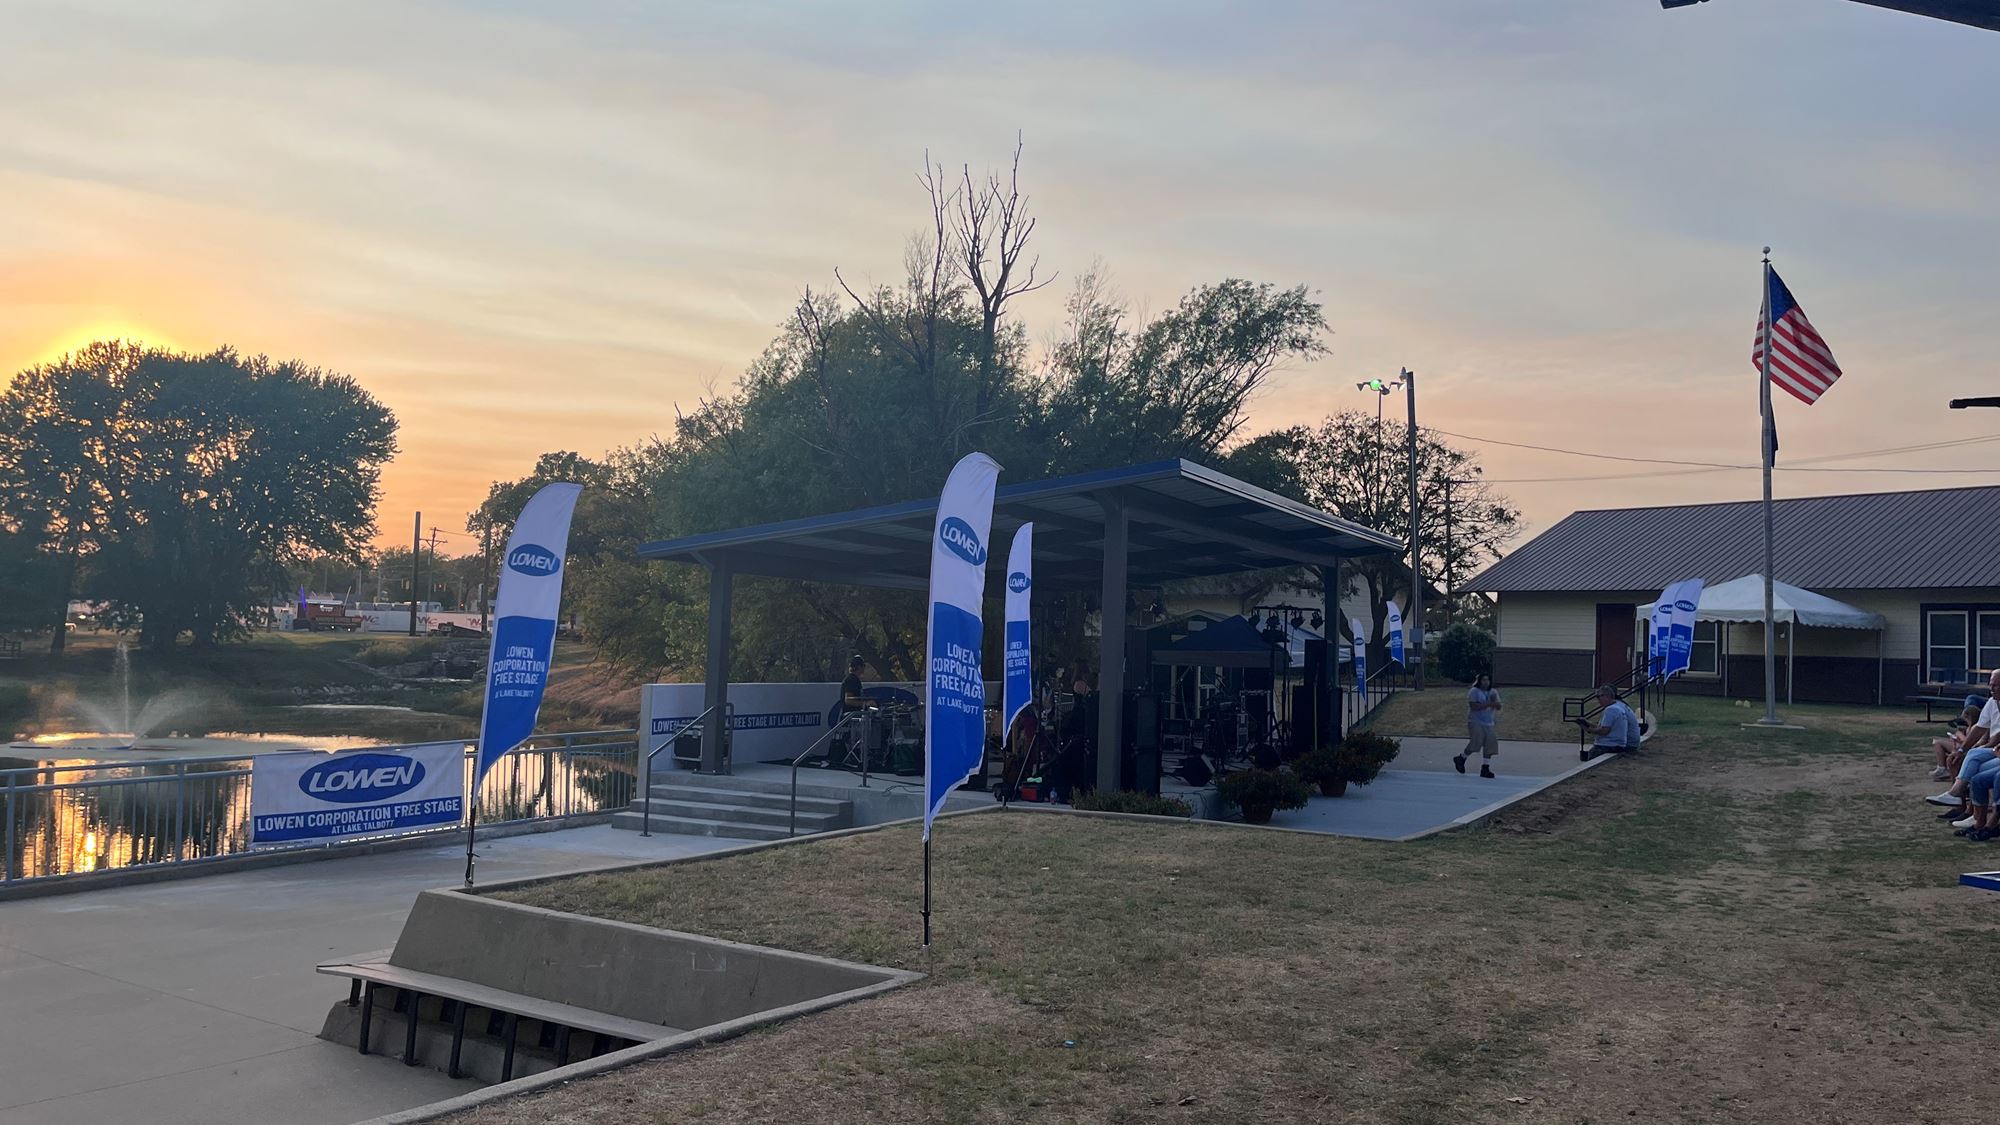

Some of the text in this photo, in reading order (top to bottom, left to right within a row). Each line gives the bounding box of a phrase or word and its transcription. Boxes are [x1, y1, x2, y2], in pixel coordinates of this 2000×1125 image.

[943, 523, 982, 561] LOWEN
[510, 552, 557, 571] LOWEN
[506, 646, 534, 659] LOWEN
[935, 674, 983, 700] FREE TAGE
[937, 697, 946, 706] AT
[947, 697, 962, 709] LAKE
[734, 716, 747, 728] REE
[747, 715, 768, 728] STAGE
[768, 715, 778, 727] AT
[777, 714, 795, 727] LAKE
[794, 713, 820, 726] TALBOTT
[308, 758, 419, 793] LOWEN
[257, 799, 460, 832] LOWEN CORPORATION FREE STAGE
[331, 819, 395, 835] AT LAKE TALBOTT
